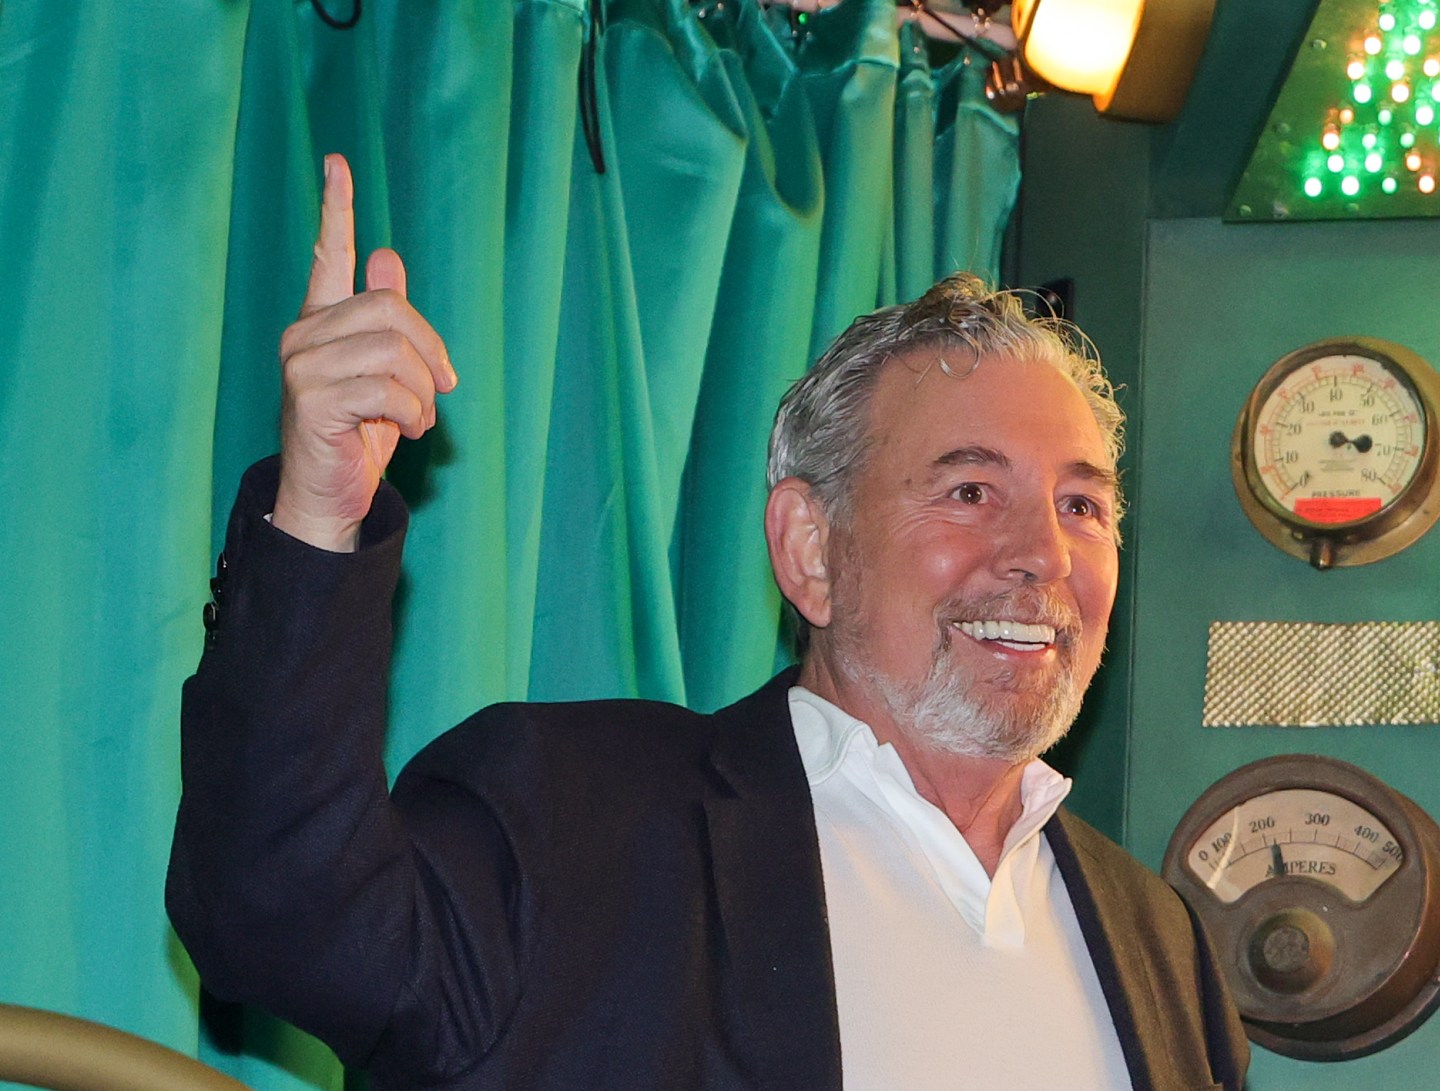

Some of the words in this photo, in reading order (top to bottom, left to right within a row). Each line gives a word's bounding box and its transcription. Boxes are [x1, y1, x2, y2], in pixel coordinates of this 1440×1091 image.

[1375, 443, 1392, 456] 70
[1361, 468, 1377, 481] 80
[1311, 488, 1362, 498] PRESSURE
[1249, 816, 1276, 834] 200
[1304, 812, 1331, 827] 300
[1353, 825, 1380, 843] 400
[1198, 849, 1209, 862] 0
